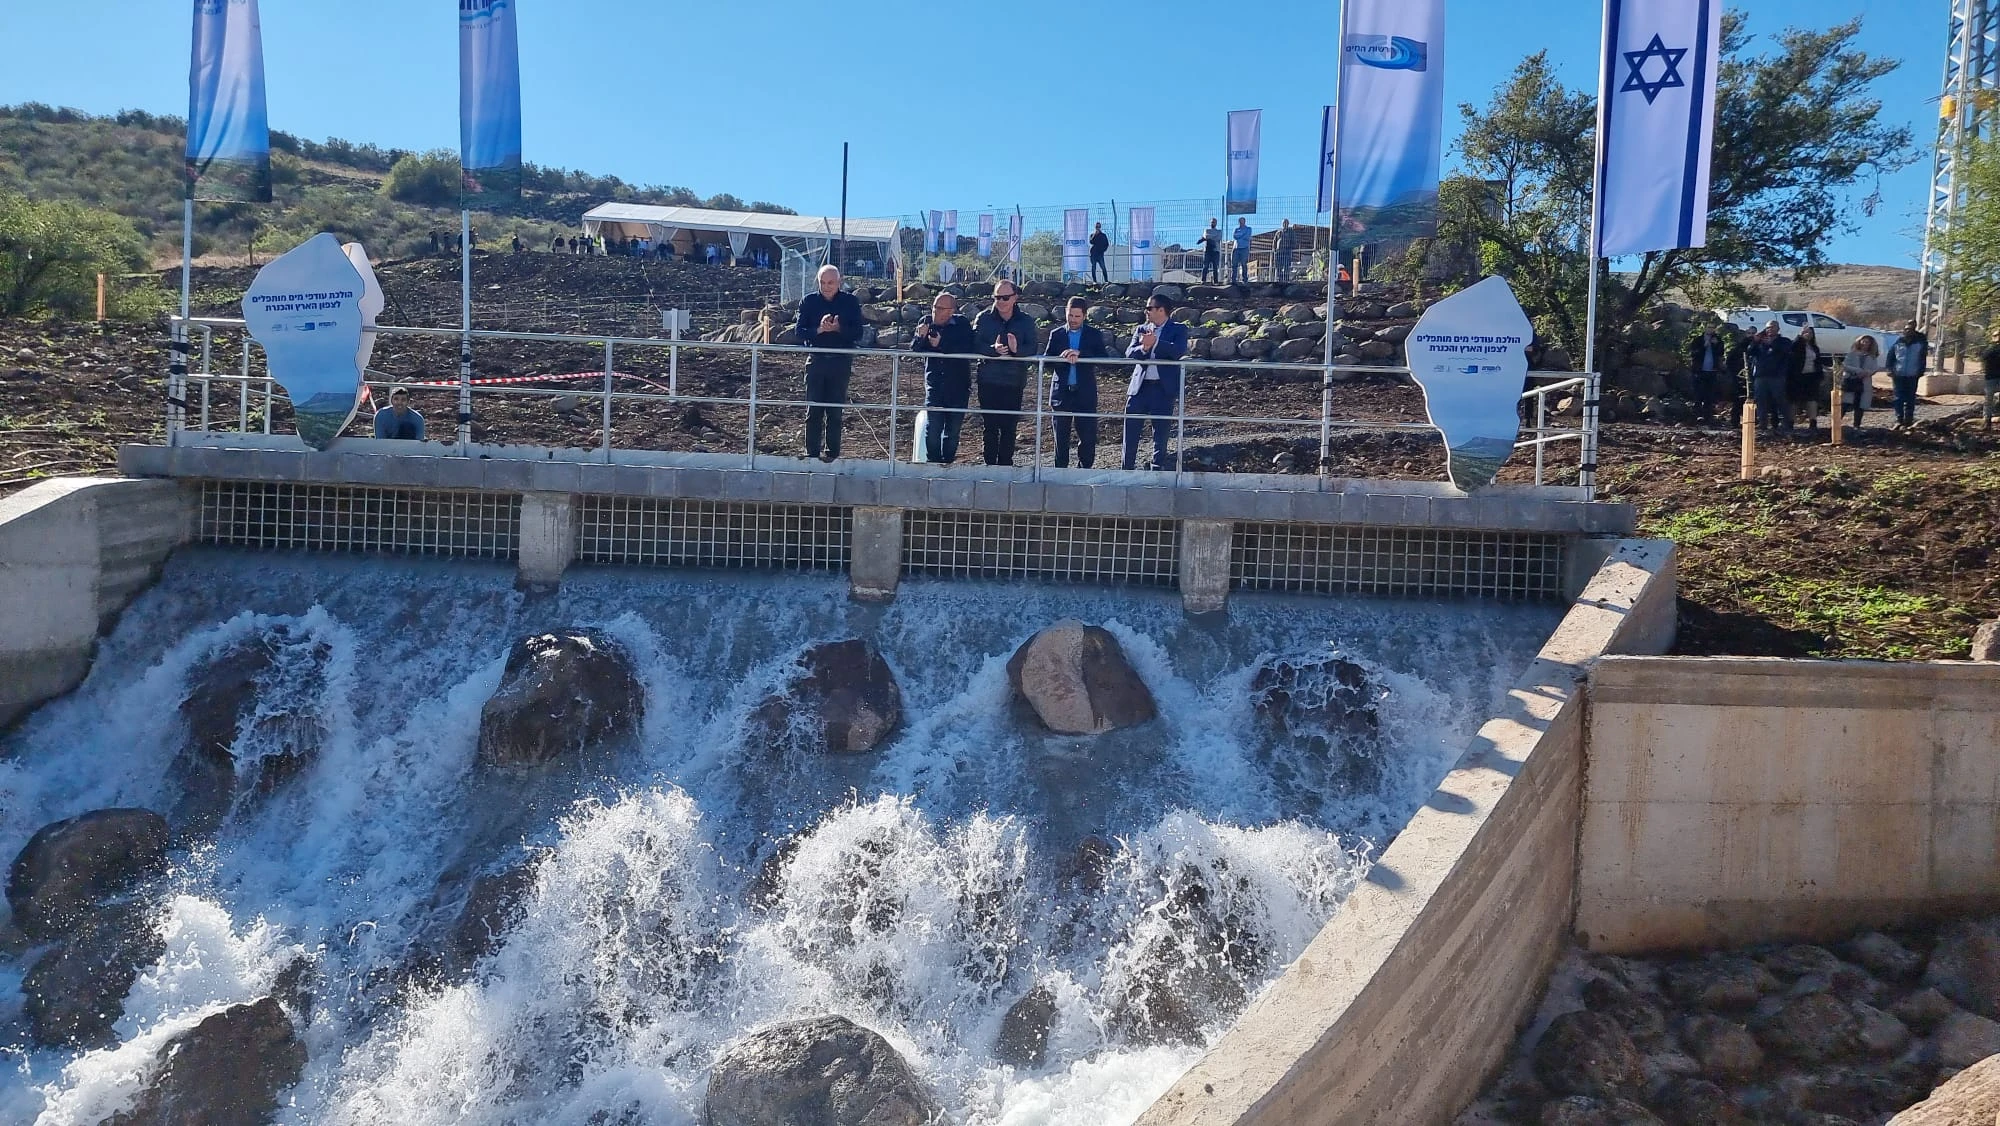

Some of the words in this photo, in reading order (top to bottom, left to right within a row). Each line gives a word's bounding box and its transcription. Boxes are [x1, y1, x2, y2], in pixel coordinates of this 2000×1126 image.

[296, 303, 317, 311] הארץ
[319, 301, 341, 309] לצפון
[1417, 334, 1451, 342] מותפלים
[1485, 345, 1507, 353] לצפון
